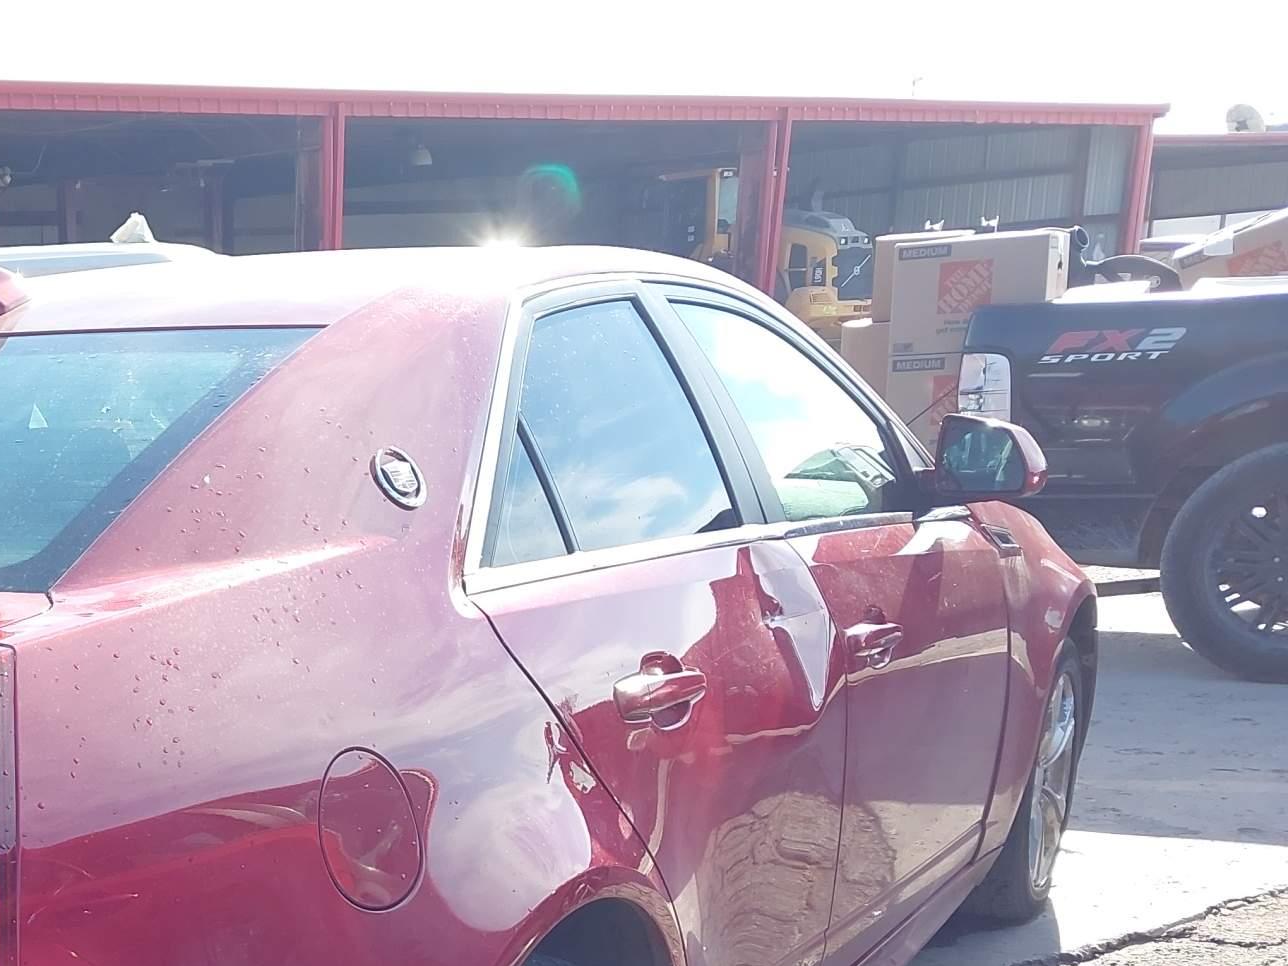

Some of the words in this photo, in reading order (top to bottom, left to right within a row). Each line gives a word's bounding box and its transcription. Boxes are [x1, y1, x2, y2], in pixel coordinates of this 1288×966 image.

[902, 246, 949, 258] MEDIUM
[937, 263, 991, 314] HOME
[1047, 327, 1187, 354] FX2
[1037, 350, 1170, 364] SPORT
[896, 360, 941, 370] MEDIUM
